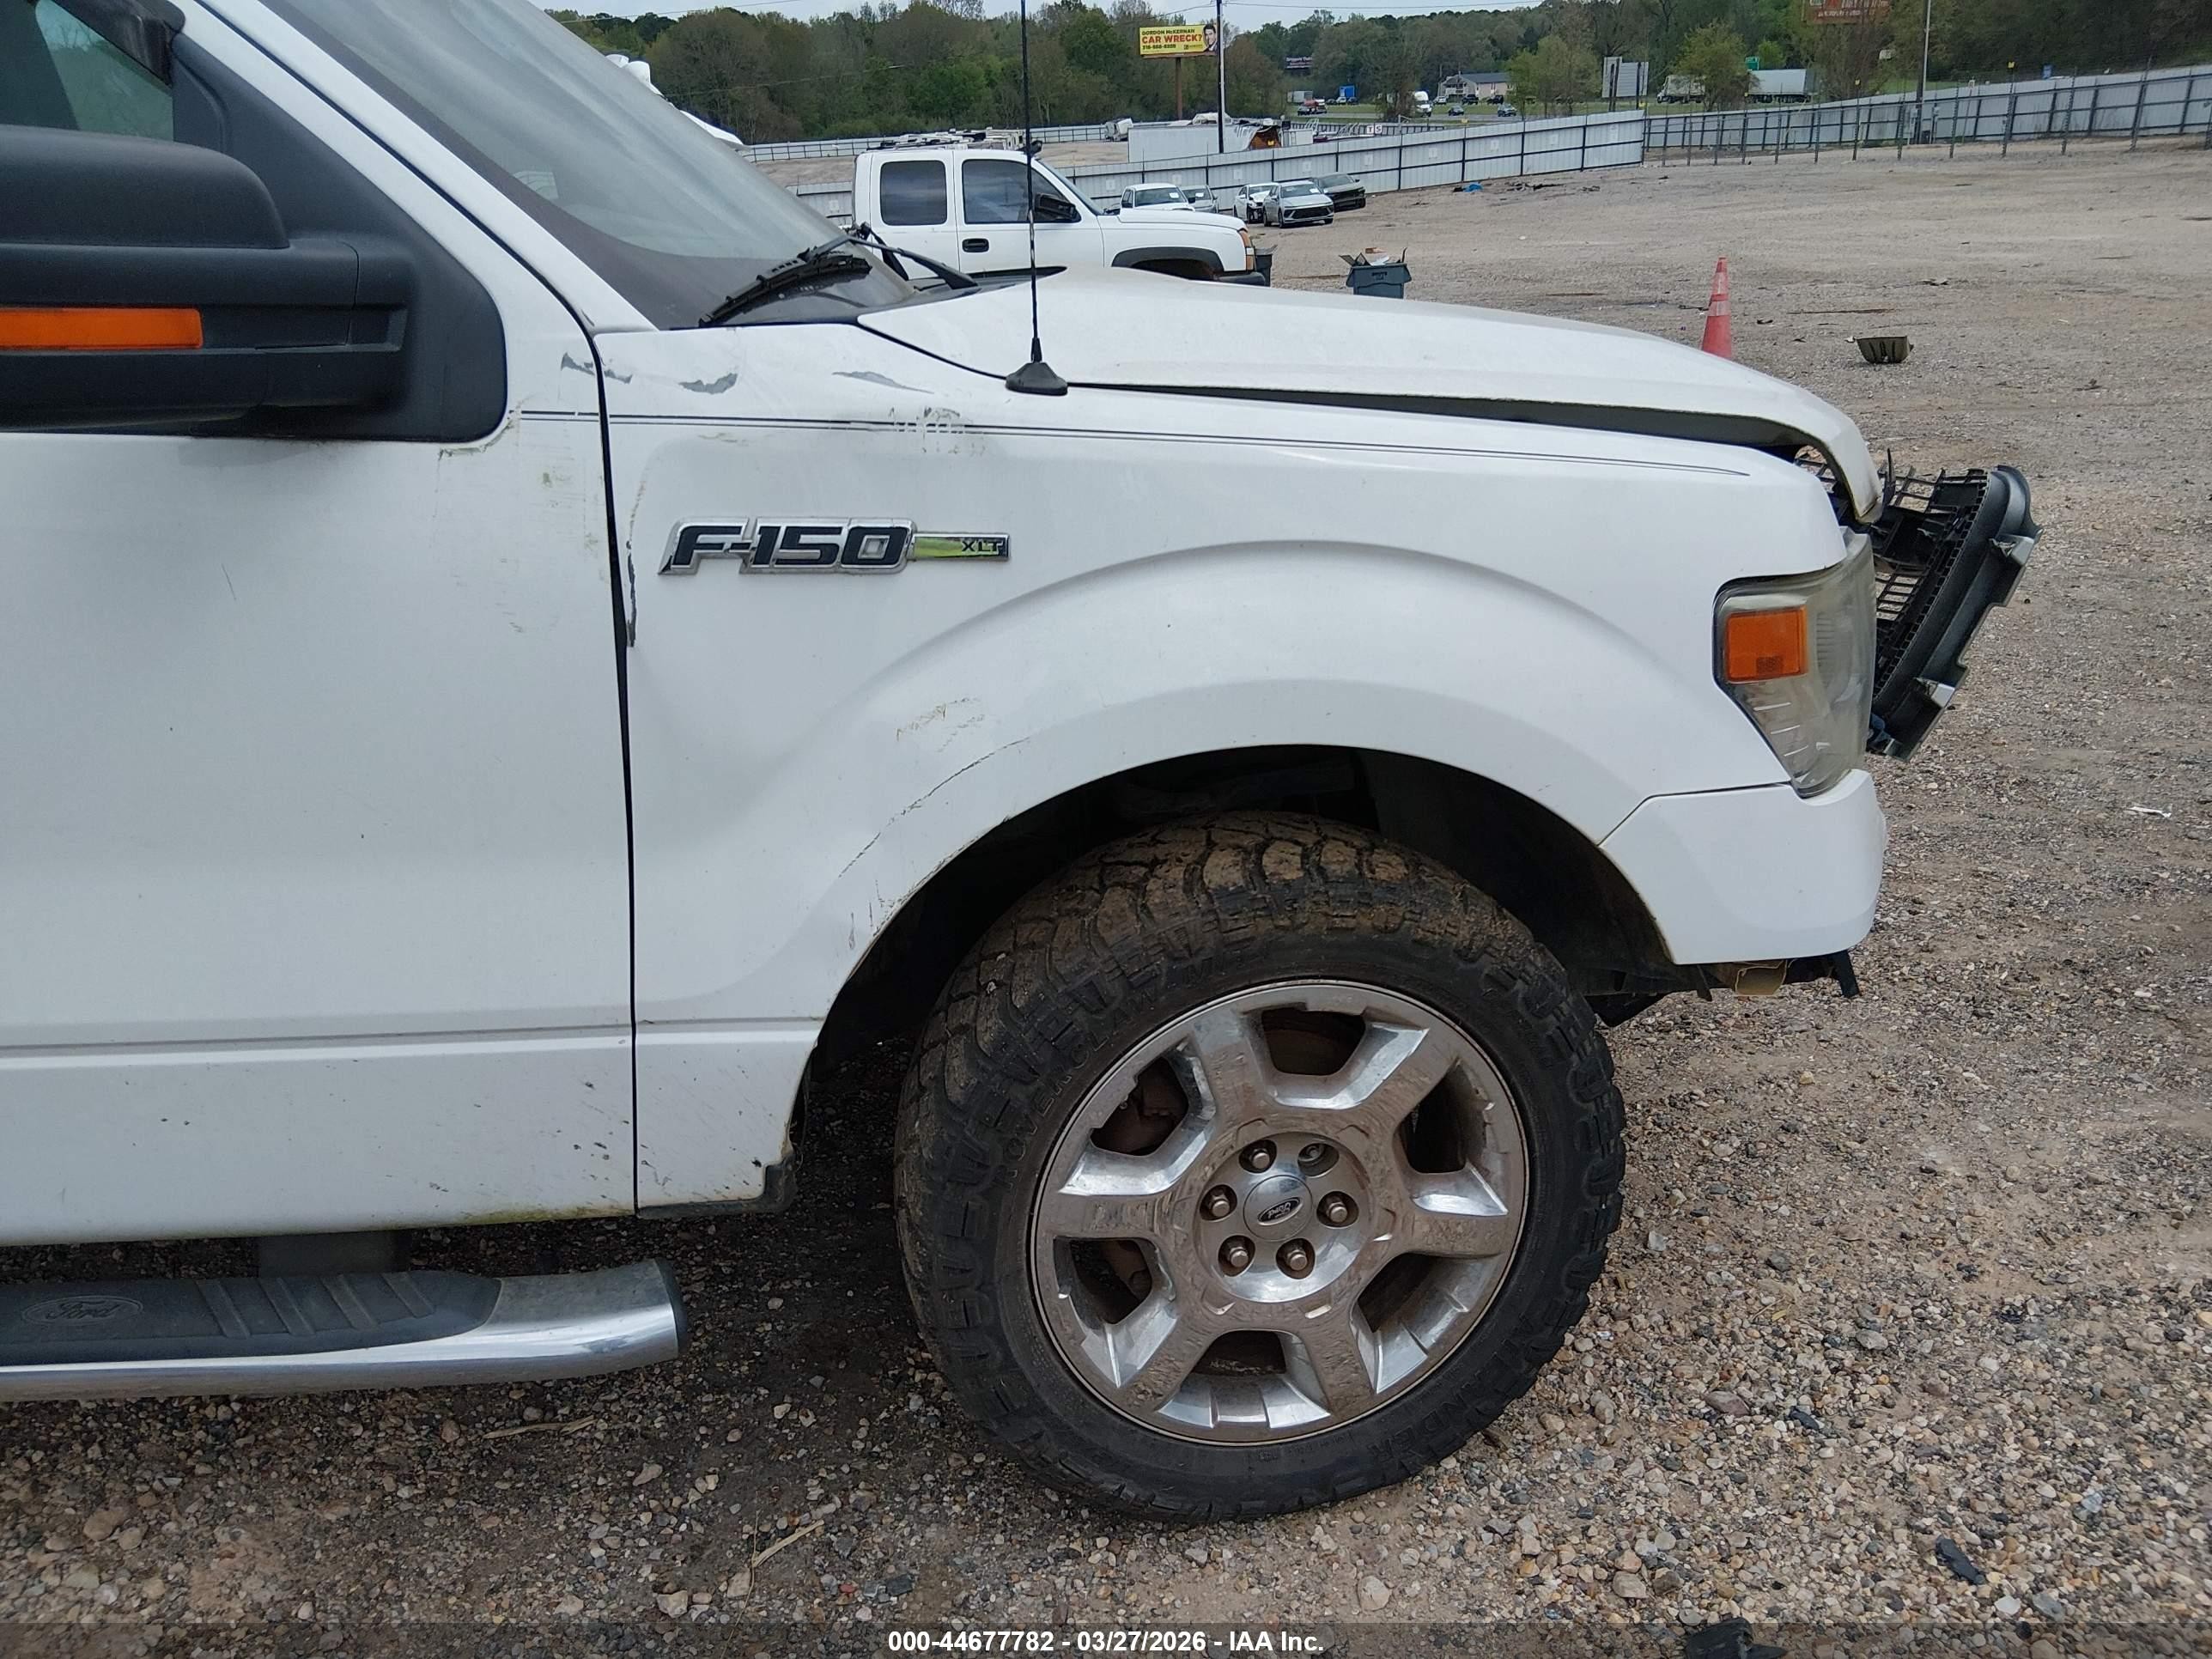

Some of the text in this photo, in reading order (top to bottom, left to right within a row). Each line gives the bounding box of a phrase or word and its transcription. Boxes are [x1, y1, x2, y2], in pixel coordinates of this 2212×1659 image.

[1141, 33, 1202, 44] CAR WRECK?
[659, 518, 1005, 574] F-150 XLT
[1266, 1201, 1291, 1218] Ford
[46, 1299, 122, 1321] Ford
